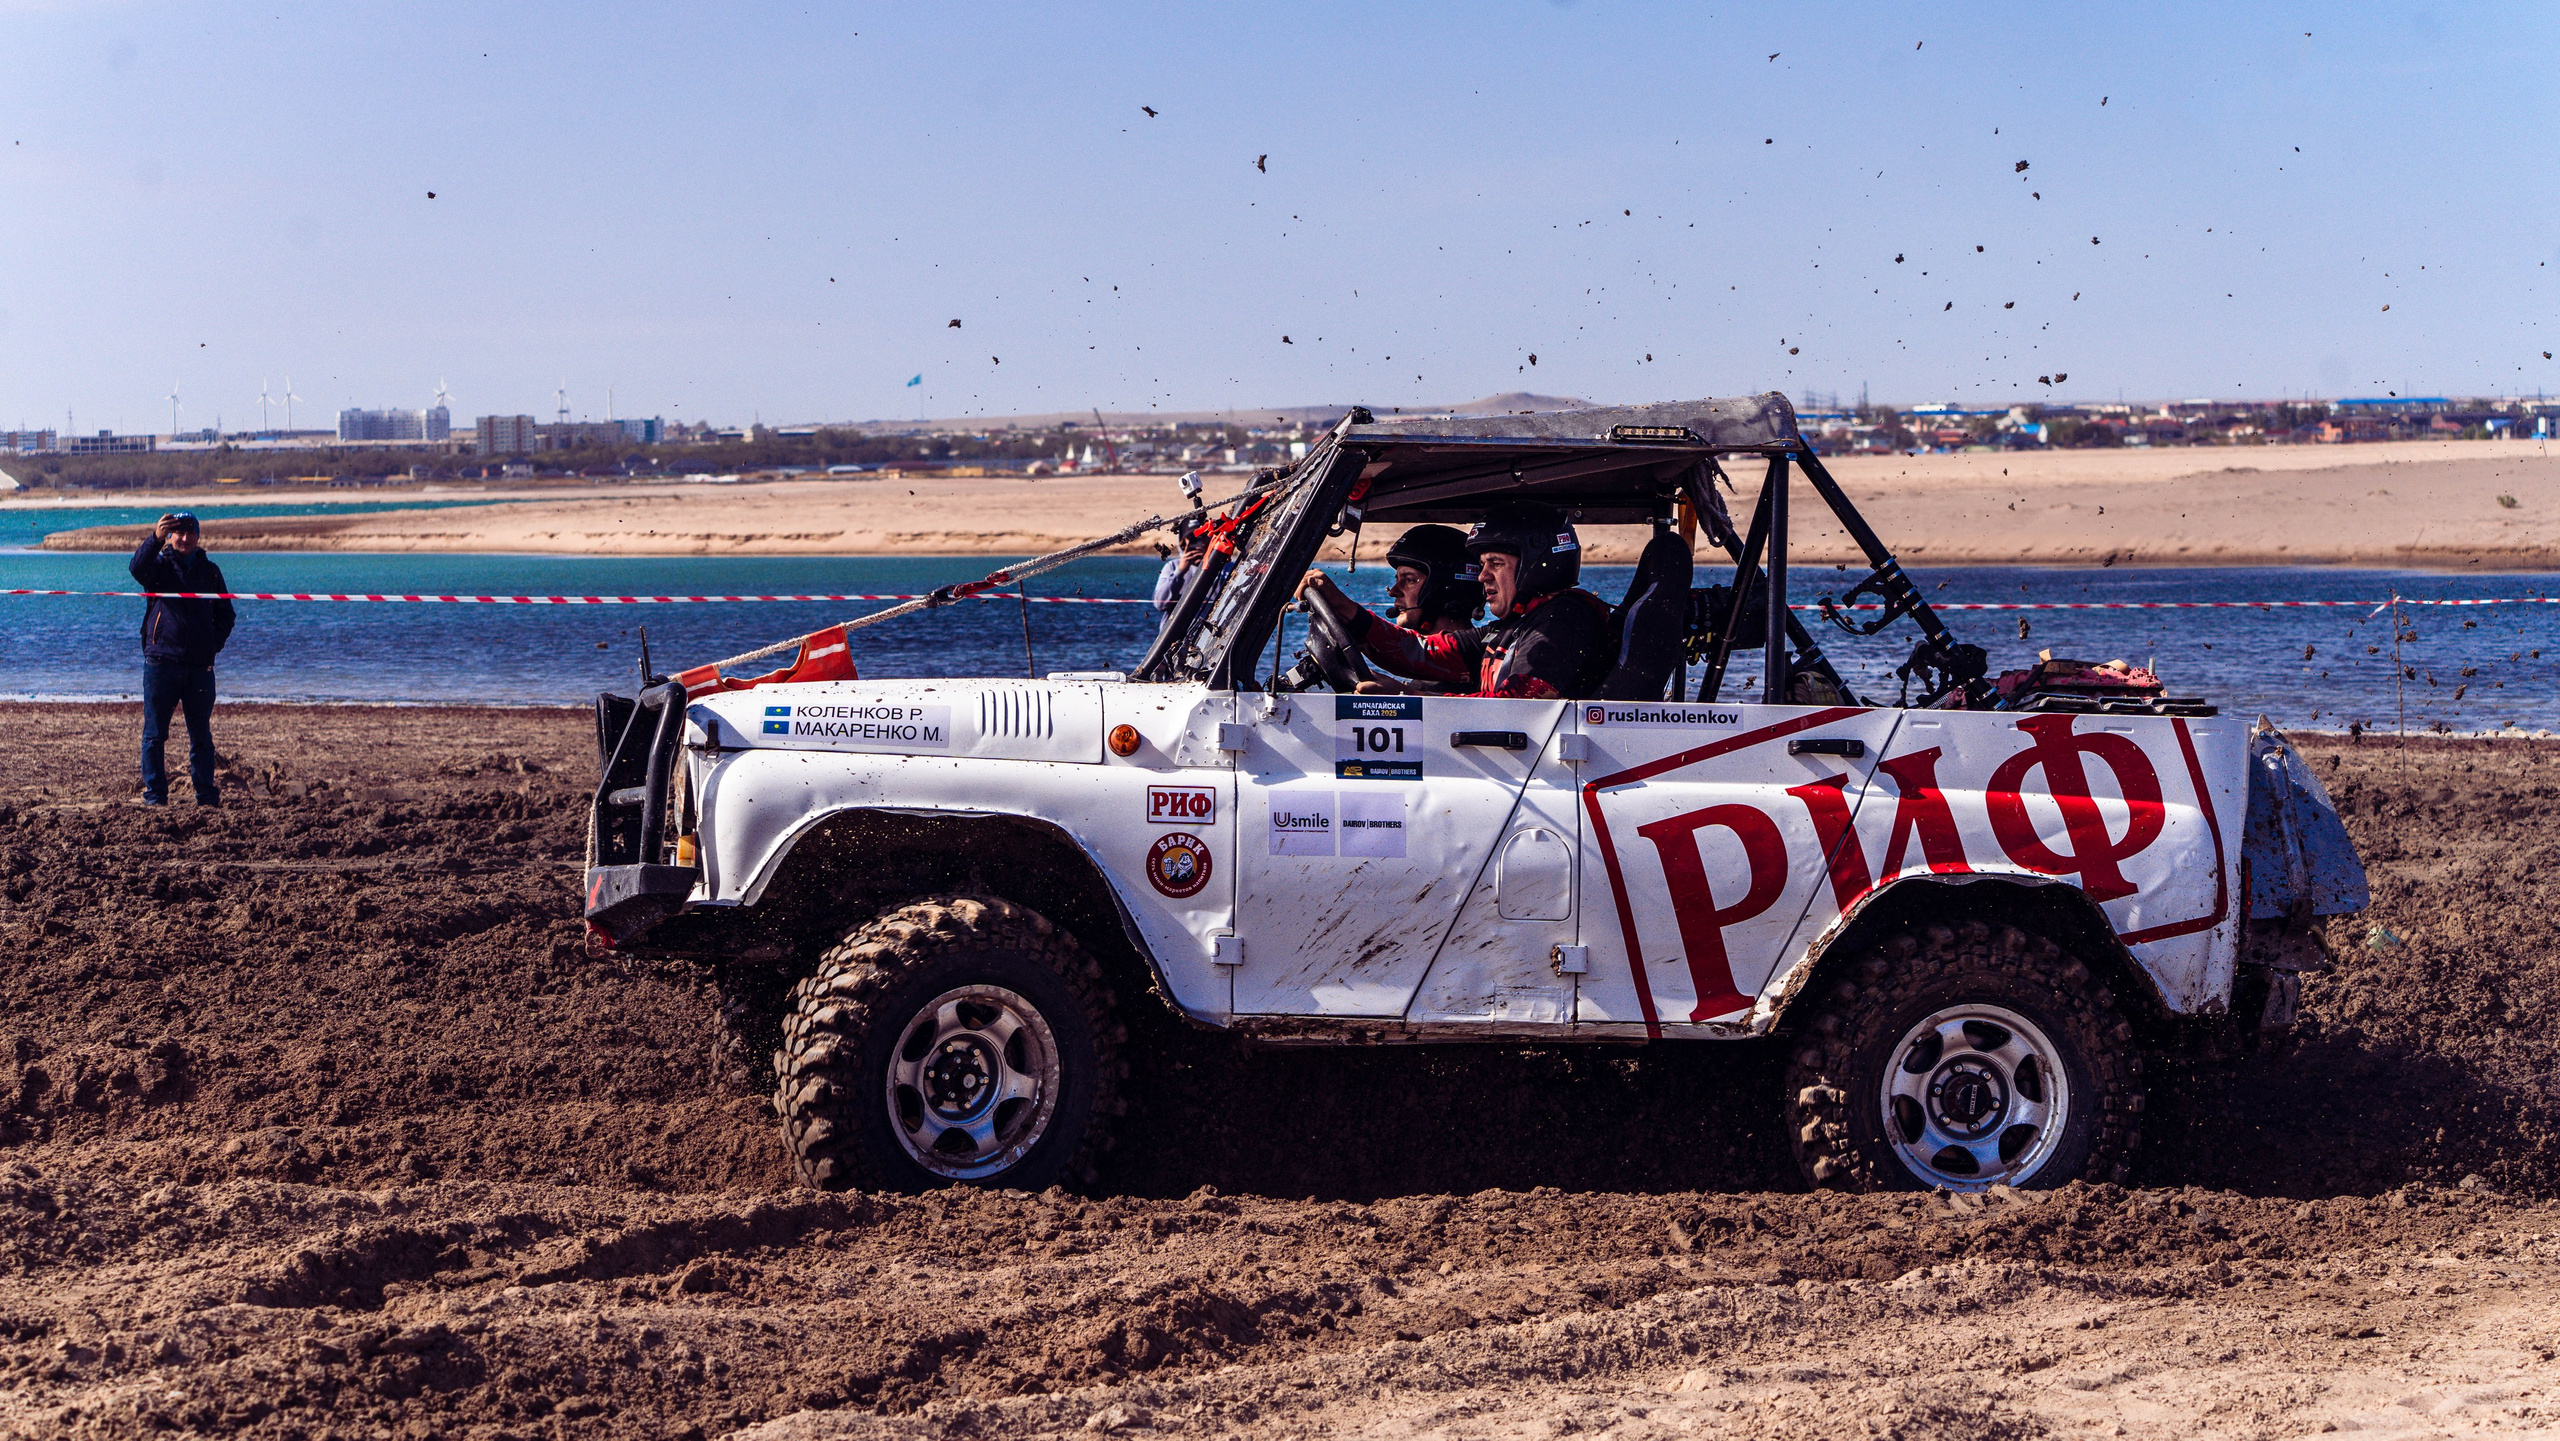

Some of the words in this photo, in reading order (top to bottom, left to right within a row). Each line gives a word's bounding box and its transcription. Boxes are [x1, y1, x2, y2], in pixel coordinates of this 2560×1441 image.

[796, 706, 903, 720] КОЛЕНКОВ
[910, 708, 923, 721] Р.
[1352, 702, 1405, 710] КАПЧАГАЙСКАЯ
[1381, 709, 1397, 717] 2025
[1608, 708, 1738, 724] ruslankolenkov
[794, 721, 917, 741] МАКАРЕНКО
[923, 726, 943, 742] М.
[1352, 727, 1403, 753] 101
[1390, 768, 1417, 776] BROTHERS
[1151, 792, 1212, 818] РИФ
[1274, 812, 1329, 828] Usmile
[1342, 820, 1366, 828] DAIROV
[1369, 820, 1402, 829] BROTHERS
[1157, 835, 1205, 856] БАРИК
[1637, 714, 2166, 1023] РИФ
